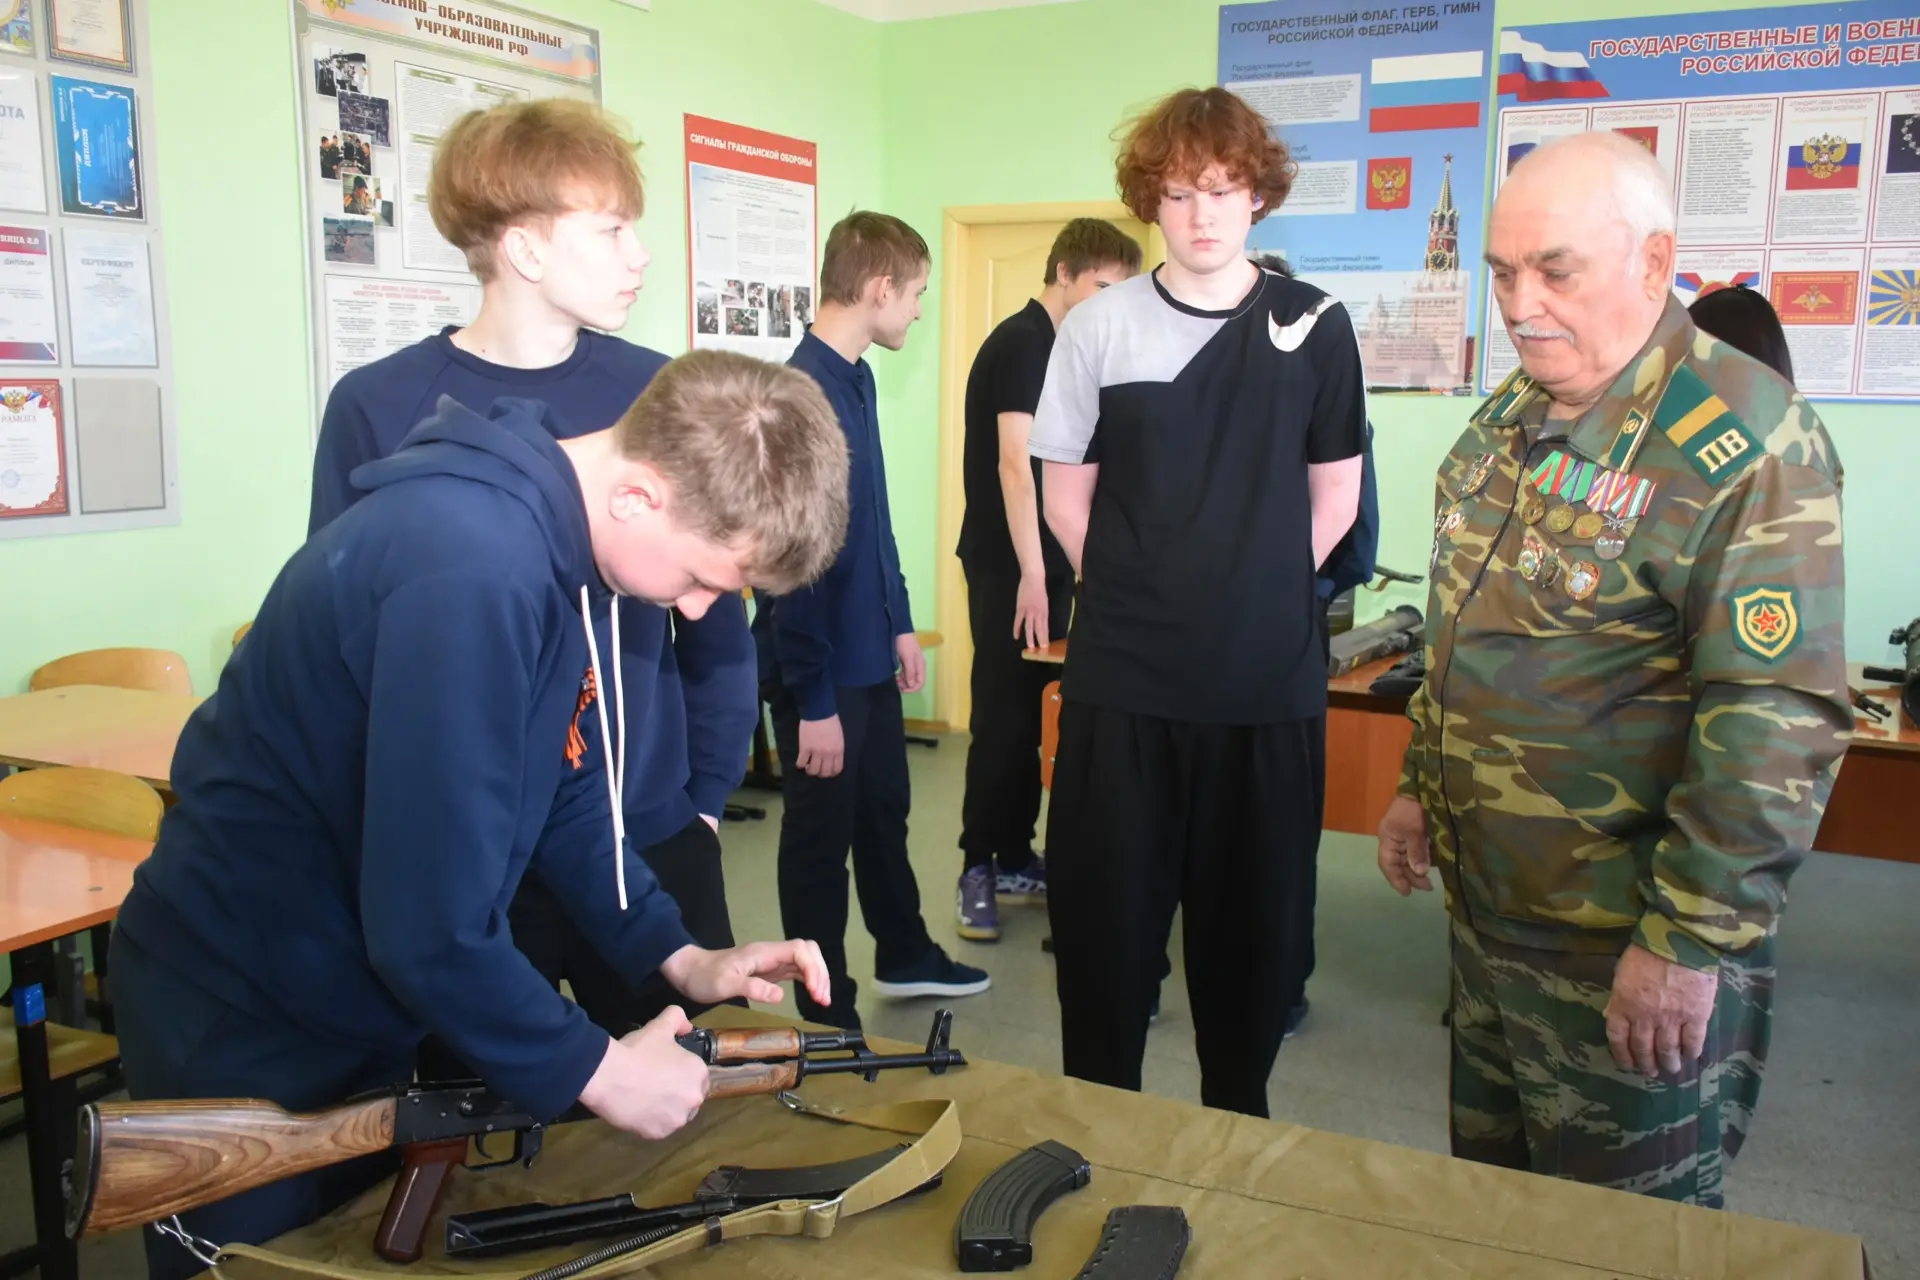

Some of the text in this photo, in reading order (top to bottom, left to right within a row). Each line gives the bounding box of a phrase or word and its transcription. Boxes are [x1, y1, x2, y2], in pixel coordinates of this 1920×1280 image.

[1231, 13, 1358, 34] ГОСУДАРСТВЕННЫЙ
[1402, 5, 1440, 19] ГЕРБ,
[1443, 1, 1481, 15] ГИМН
[1268, 20, 1439, 45] РОССИЙСКОЙ ФЕДЕРАЦИИ
[414, 17, 529, 56] УЧРЕЖДЕНИЯ РФ
[1589, 25, 1818, 59] ГОСУДАРСТВЕННЫЕ
[1823, 23, 1842, 44] И
[1680, 44, 1841, 76] РОССИЙСКОЙ
[690, 133, 813, 168] СИГНАЛЫ ГРАЖДАНСКОЙ ОБОРОНЫ
[1695, 427, 1750, 474] ПВ
